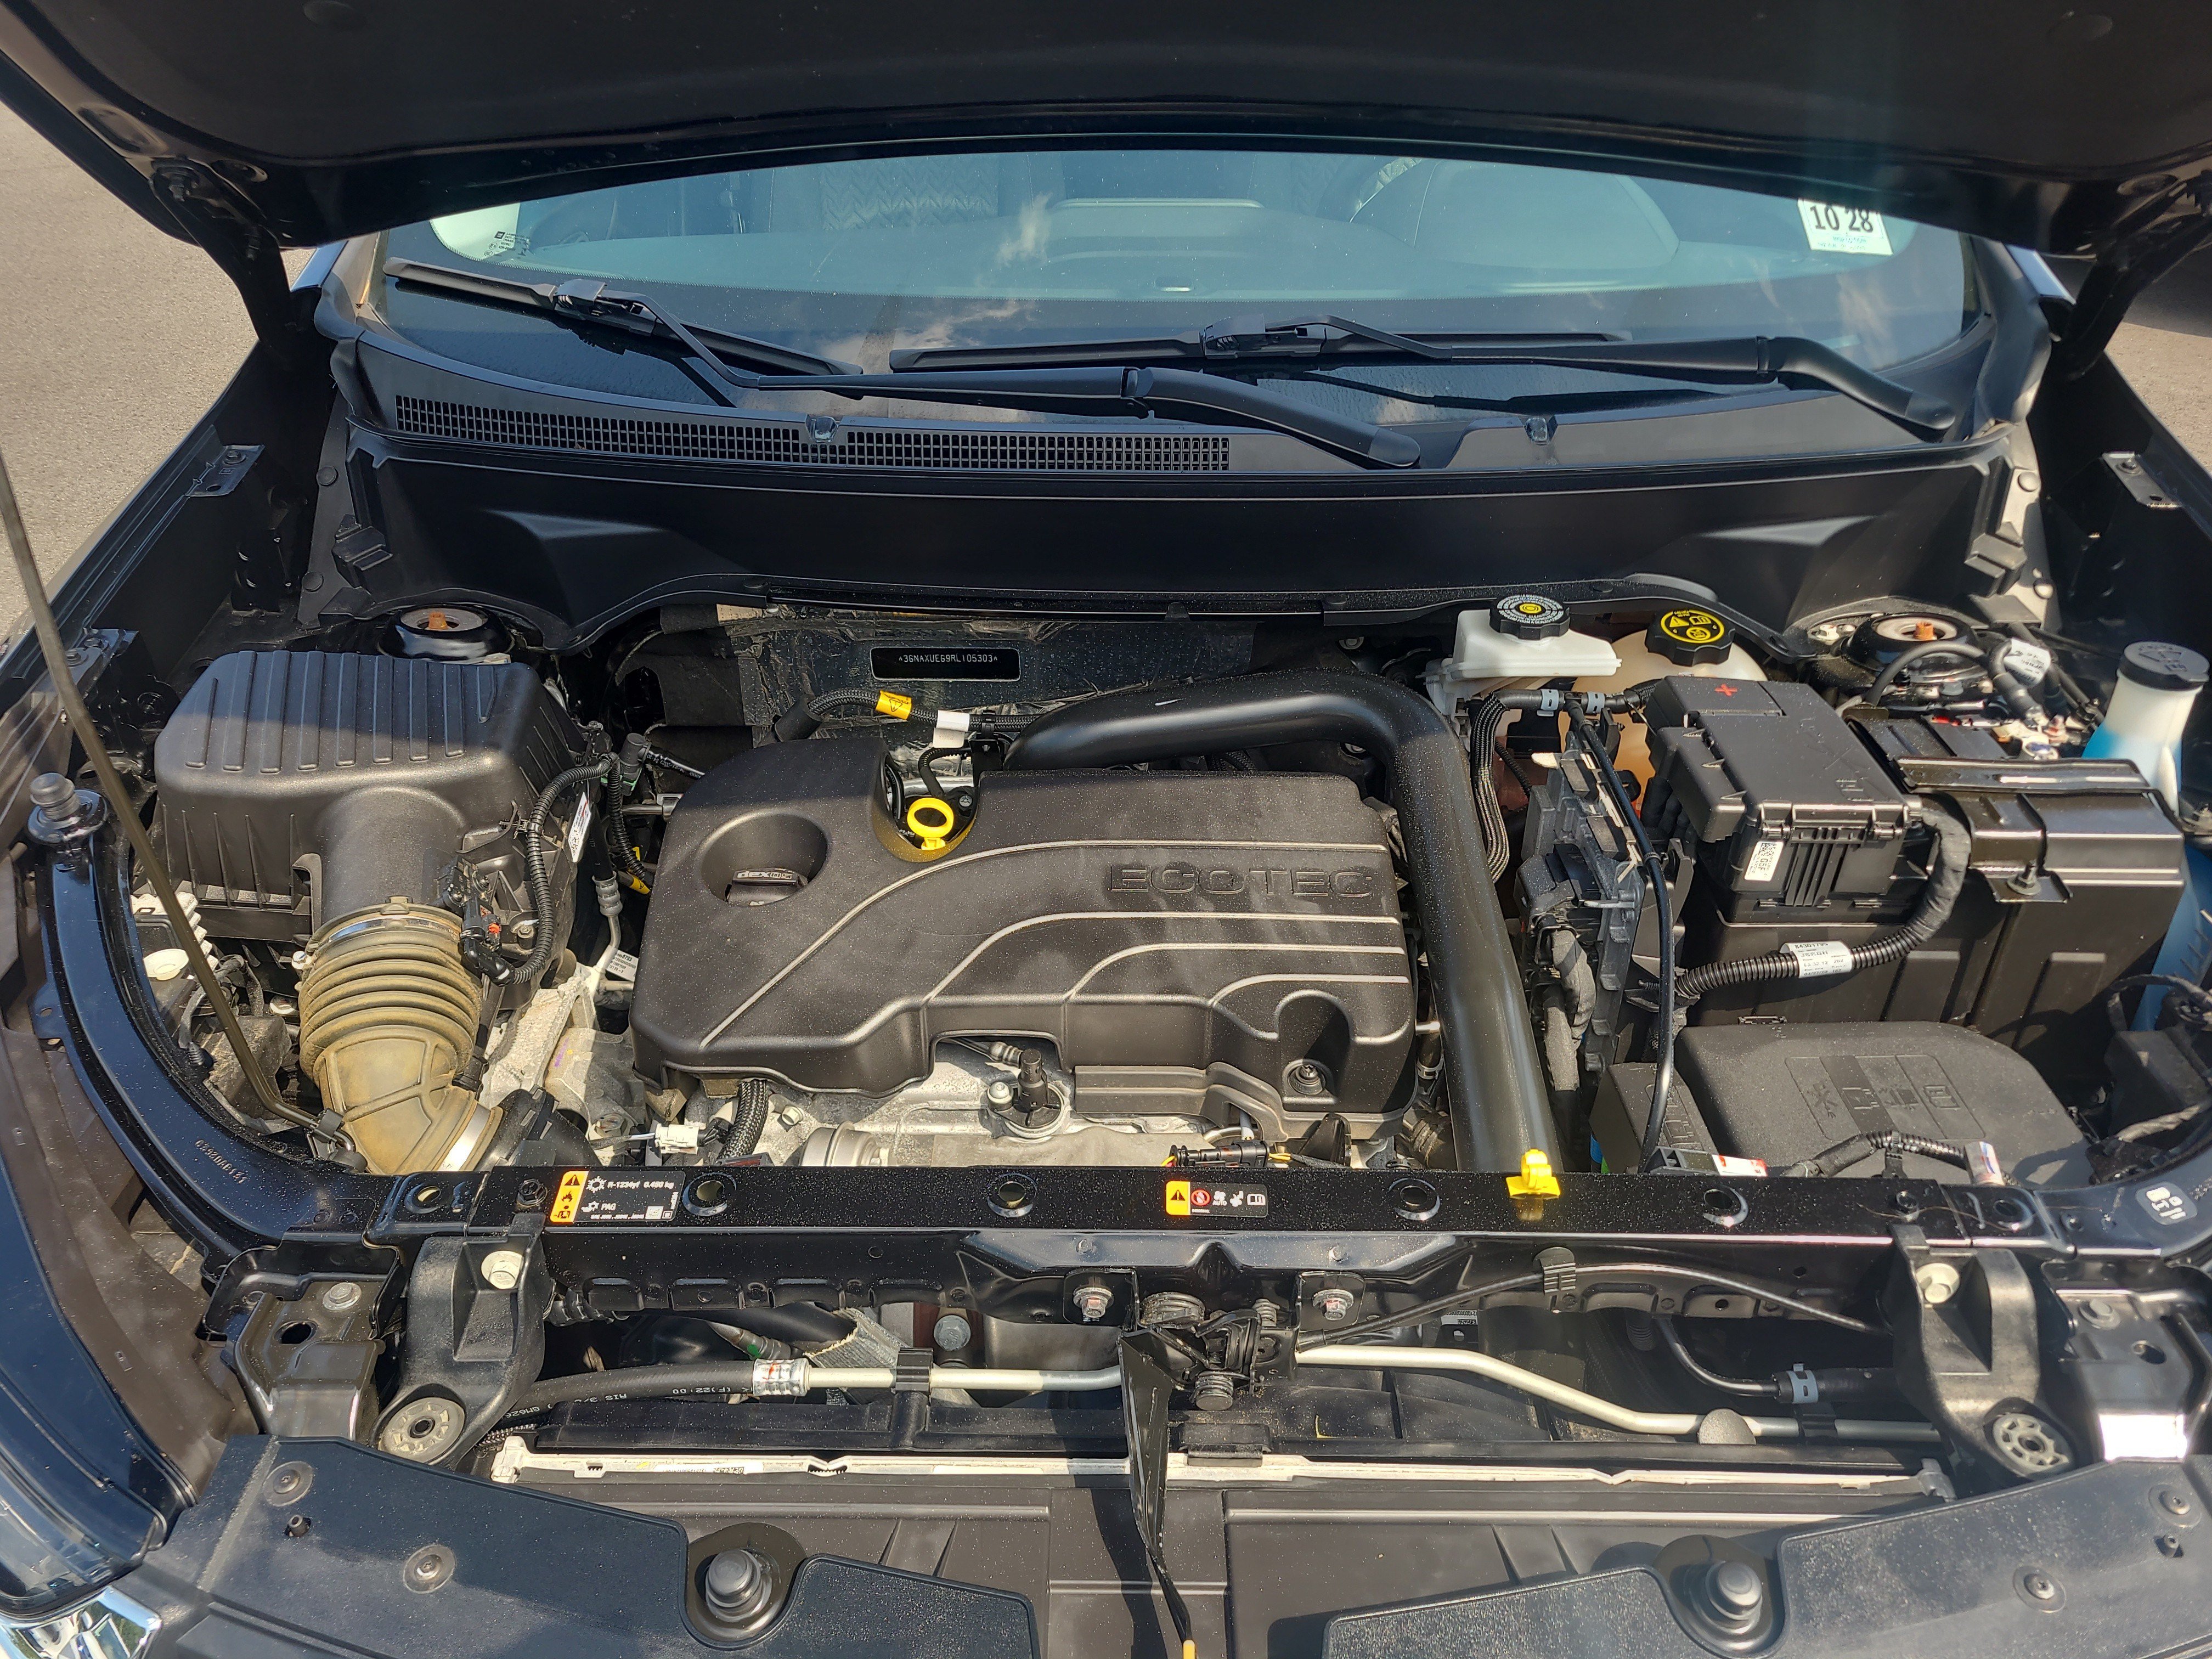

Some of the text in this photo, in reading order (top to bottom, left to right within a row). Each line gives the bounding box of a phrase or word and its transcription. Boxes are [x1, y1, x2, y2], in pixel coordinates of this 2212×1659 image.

[1810, 204, 1874, 233] 10 28
[737, 870, 793, 879] dexos
[1110, 865, 1373, 898] ECOTEC
